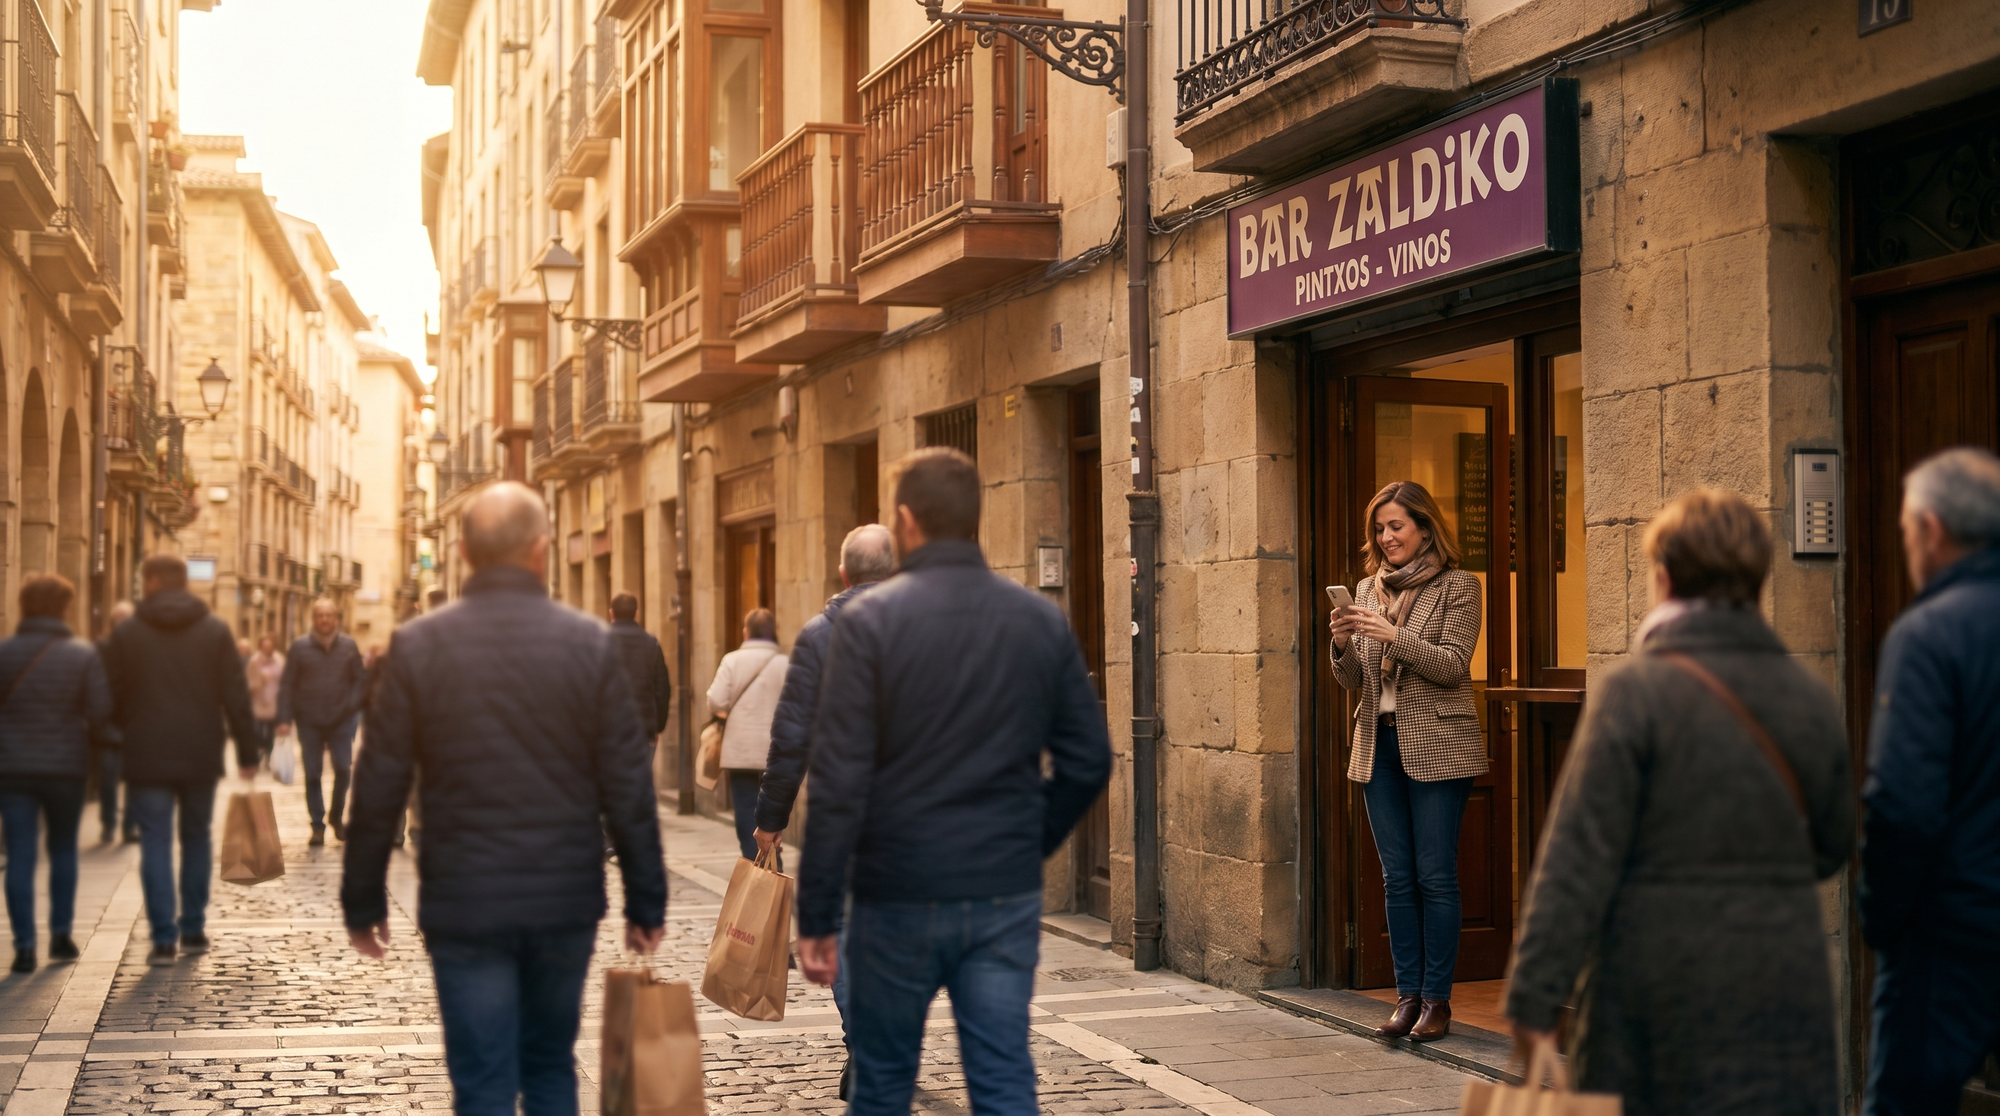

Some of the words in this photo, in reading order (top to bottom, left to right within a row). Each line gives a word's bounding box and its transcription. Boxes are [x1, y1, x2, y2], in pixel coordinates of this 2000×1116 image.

[1239, 196, 1313, 279] BAR
[1295, 255, 1370, 306] PINTXOS
[1388, 229, 1452, 278] VINOS
